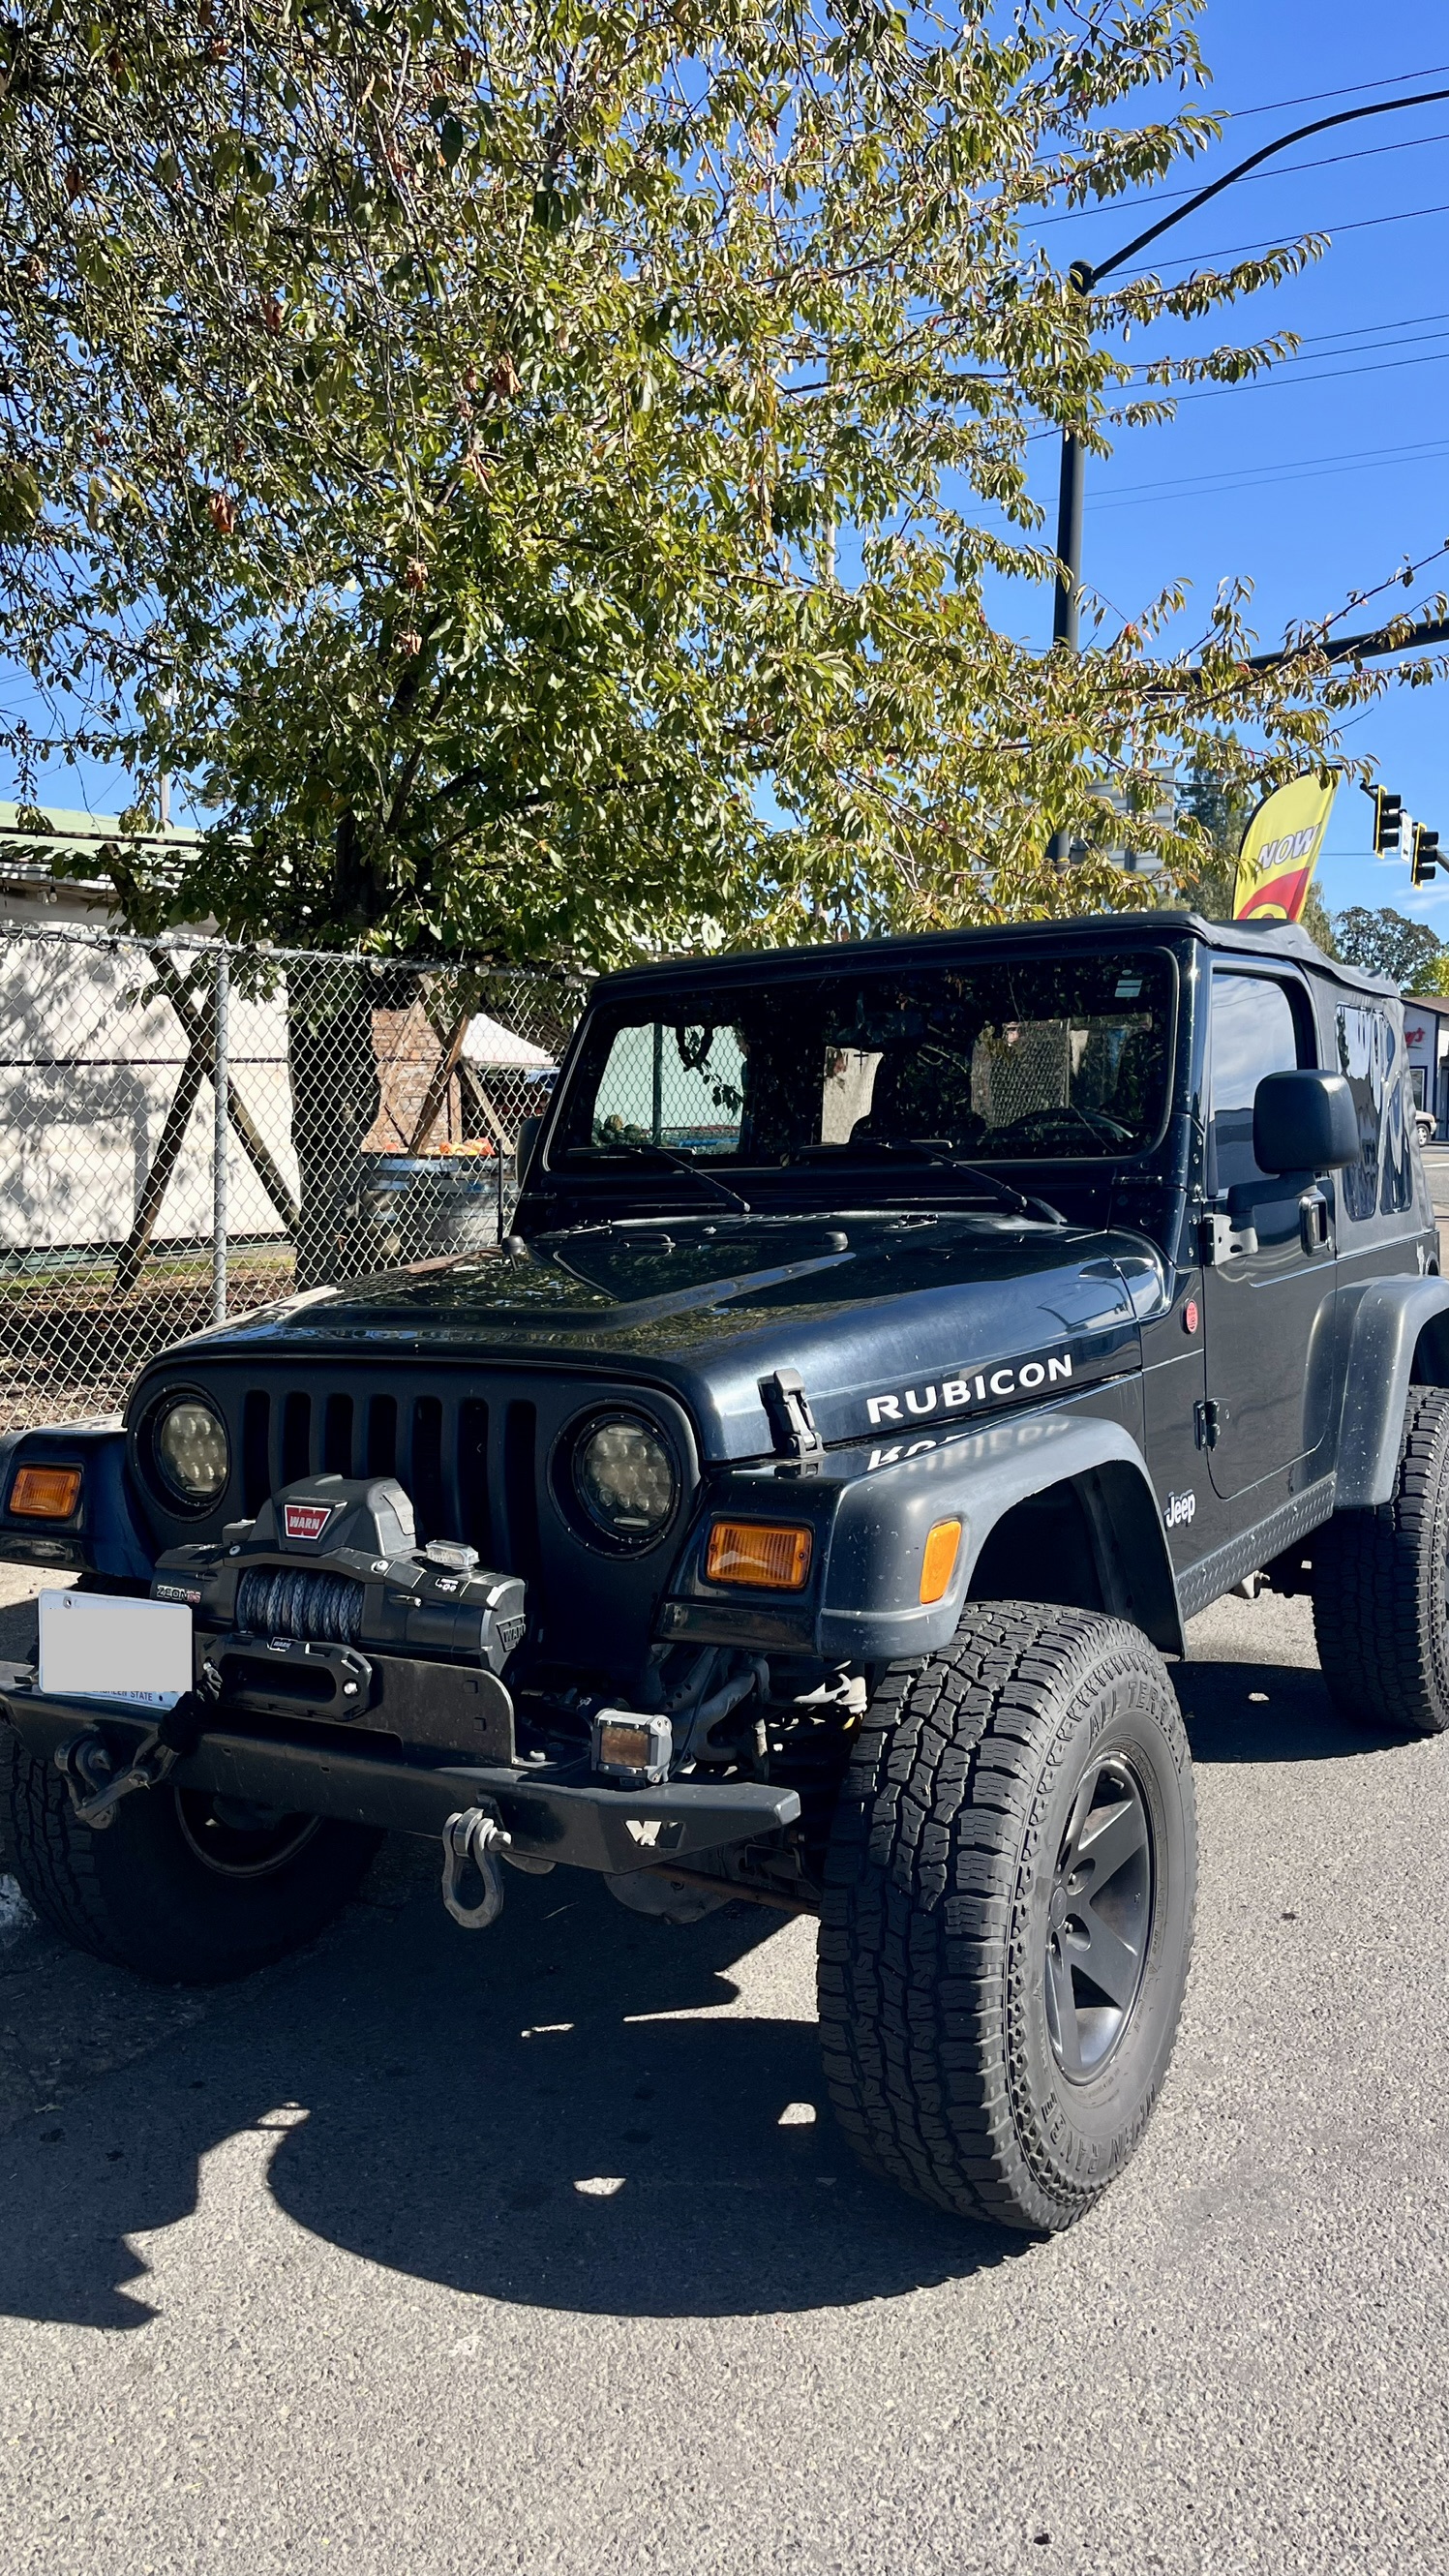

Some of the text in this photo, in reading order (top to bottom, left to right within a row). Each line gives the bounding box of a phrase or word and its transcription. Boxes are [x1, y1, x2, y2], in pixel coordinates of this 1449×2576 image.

[1255, 821, 1321, 872] NOW
[866, 1353, 1072, 1424] RUBICON
[289, 1516, 320, 1530] WARN
[1164, 1492, 1196, 1528] Jeep
[131, 1691, 153, 1702] STATE
